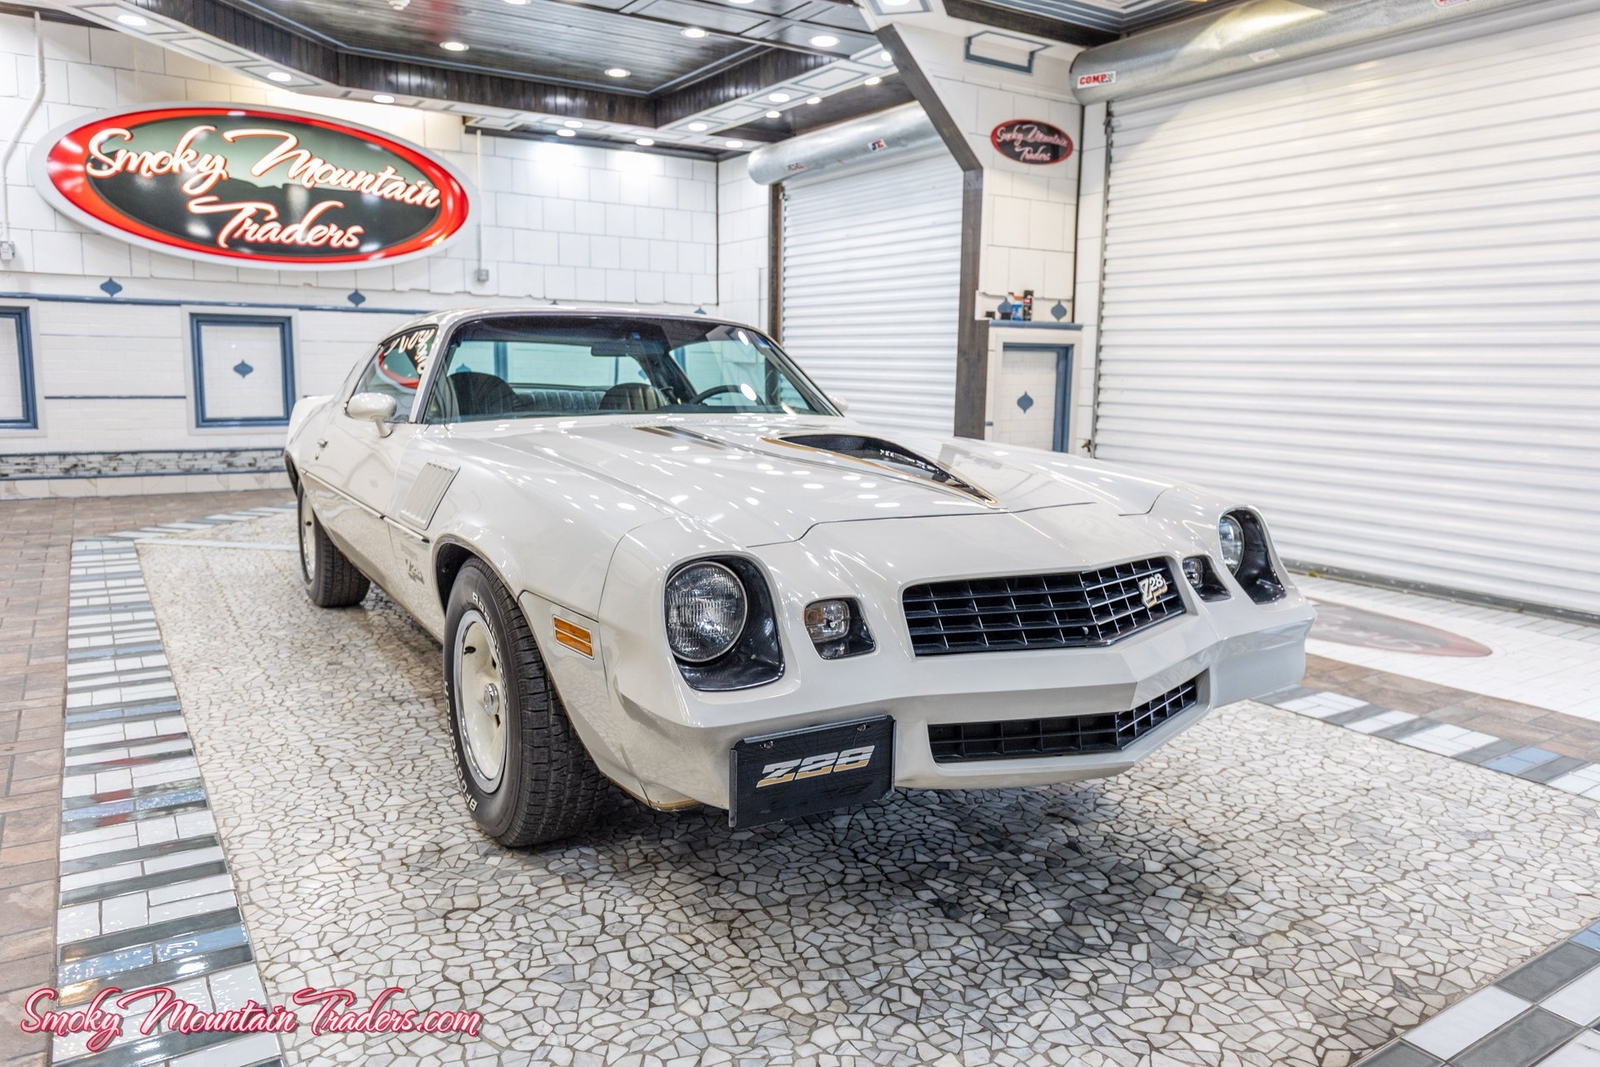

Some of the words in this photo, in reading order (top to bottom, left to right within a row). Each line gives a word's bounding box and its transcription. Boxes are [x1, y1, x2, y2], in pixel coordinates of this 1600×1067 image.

[1079, 73, 1107, 85] COMP
[996, 125, 1024, 147] Smoky
[1022, 124, 1069, 147] Mountain
[1014, 145, 1052, 162] Traders
[86, 125, 229, 195] Smoky
[222, 127, 442, 210] Mountain
[188, 197, 364, 248] Traders
[1139, 573, 1168, 609] Z28
[756, 745, 875, 788] Z28
